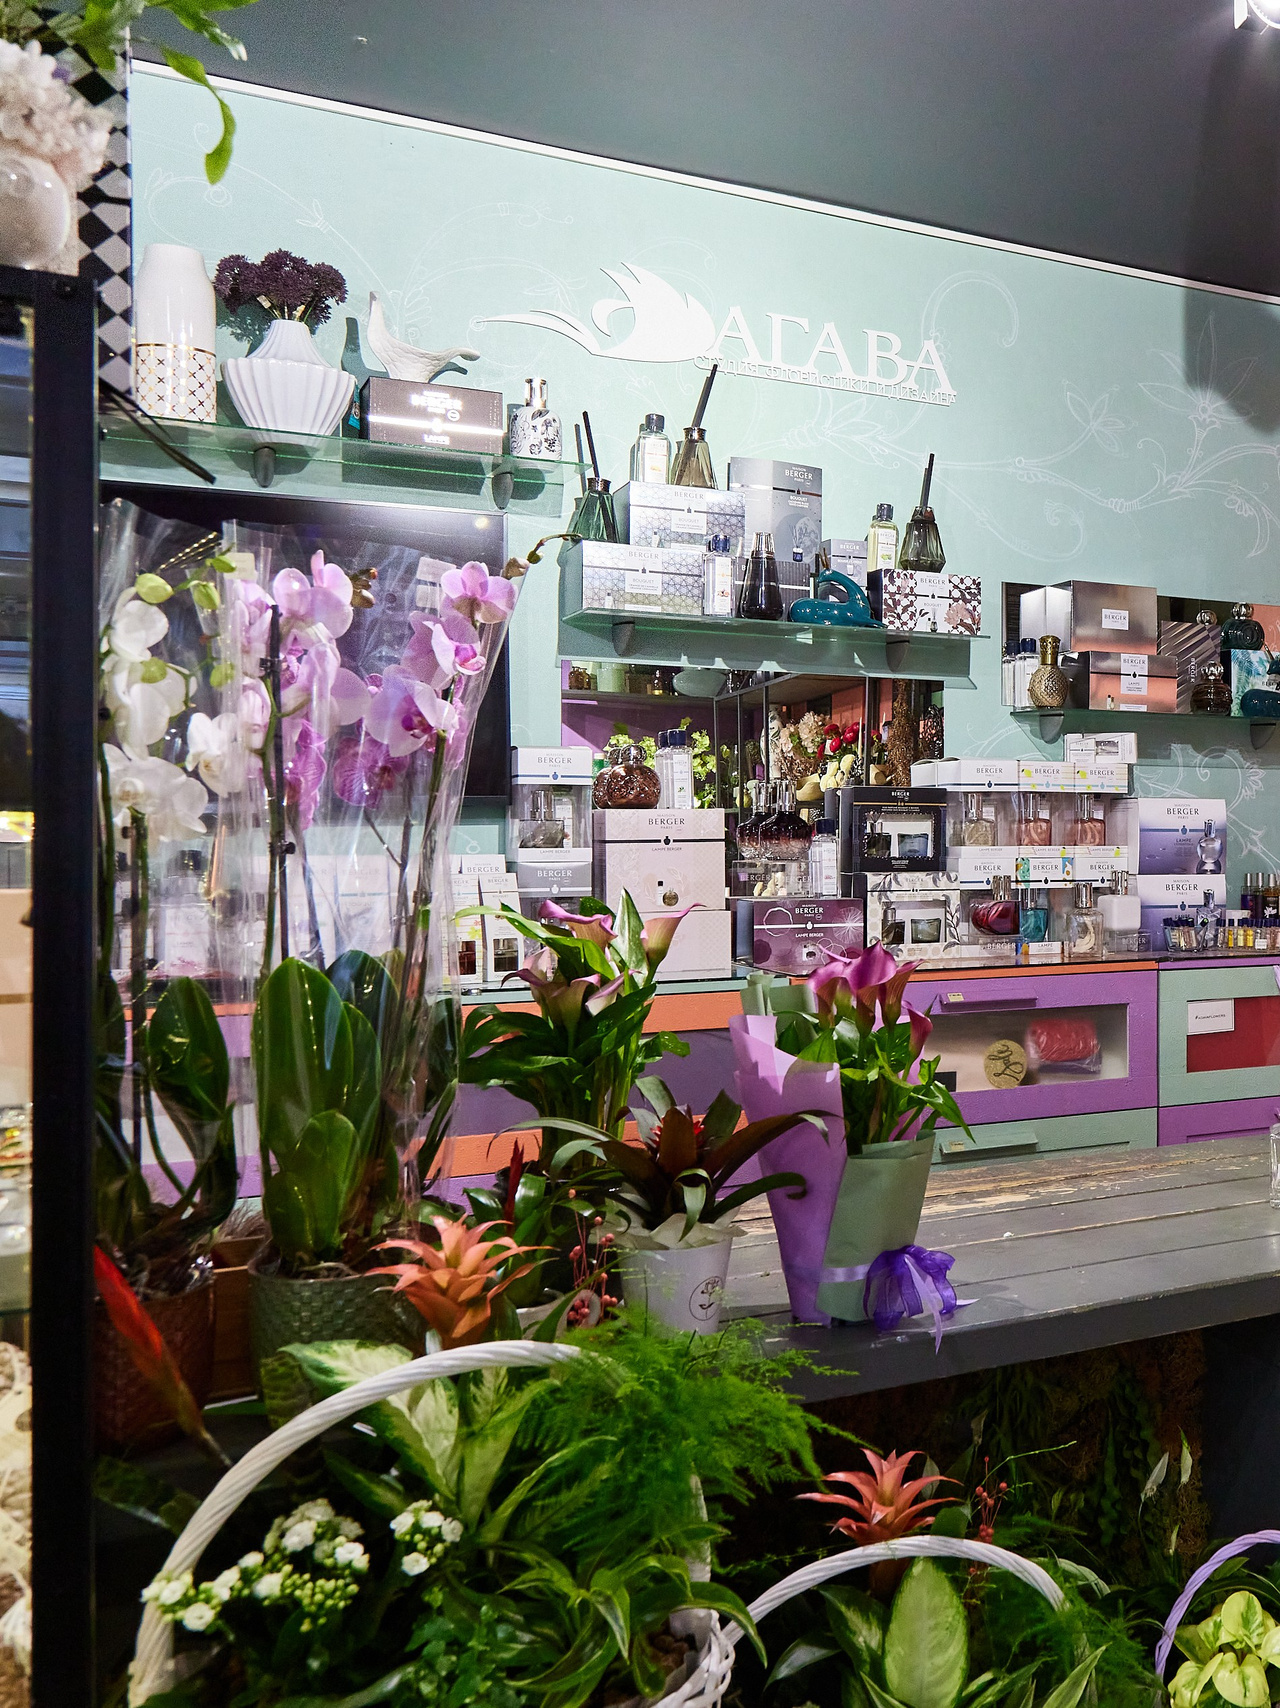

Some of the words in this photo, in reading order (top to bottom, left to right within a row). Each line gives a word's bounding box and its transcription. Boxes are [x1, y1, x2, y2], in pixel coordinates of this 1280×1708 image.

[705, 306, 957, 395] АГАВА
[693, 355, 760, 376] СТУДИЯ
[765, 364, 869, 392] ФЛОРИСТИКИ
[784, 469, 813, 481] BERGER
[674, 491, 704, 500] BERGER
[628, 550, 659, 560] BERGER
[920, 578, 946, 586] BERGER
[1104, 613, 1127, 621] BERGER
[1122, 658, 1146, 666] BERGER
[1166, 807, 1200, 816] BERGER
[648, 818, 685, 826] BERGER
[740, 874, 771, 883] BERGER
[1165, 883, 1199, 892] BERGER
[1122, 936, 1146, 945] BERGER
[987, 942, 1016, 950] BERGER
